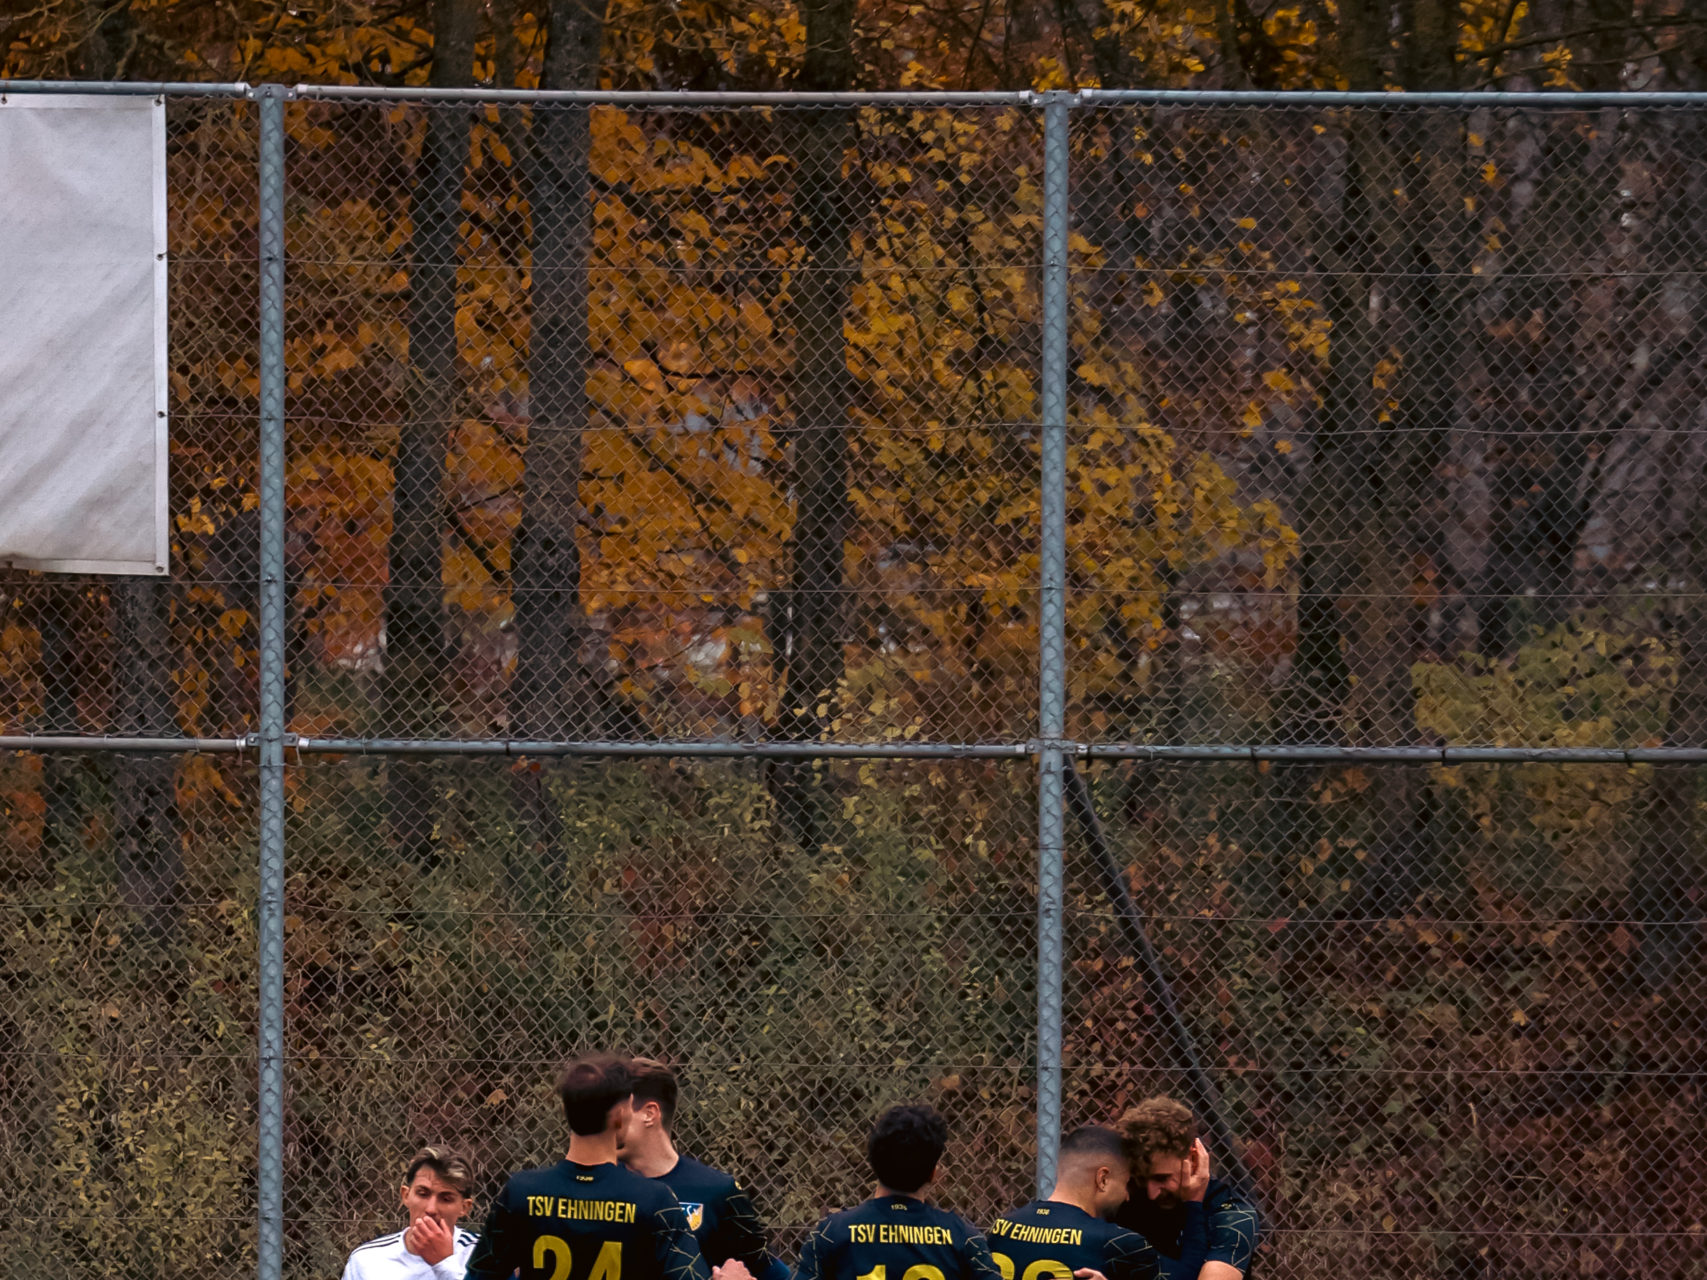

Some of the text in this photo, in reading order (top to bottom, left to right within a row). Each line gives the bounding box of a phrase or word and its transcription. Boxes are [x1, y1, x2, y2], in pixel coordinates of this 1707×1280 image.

[527, 1195, 637, 1224] TSV EHNINGEN
[848, 1223, 954, 1246] TSV EHNINGEN
[991, 1218, 1083, 1246] SV EHNINGEN
